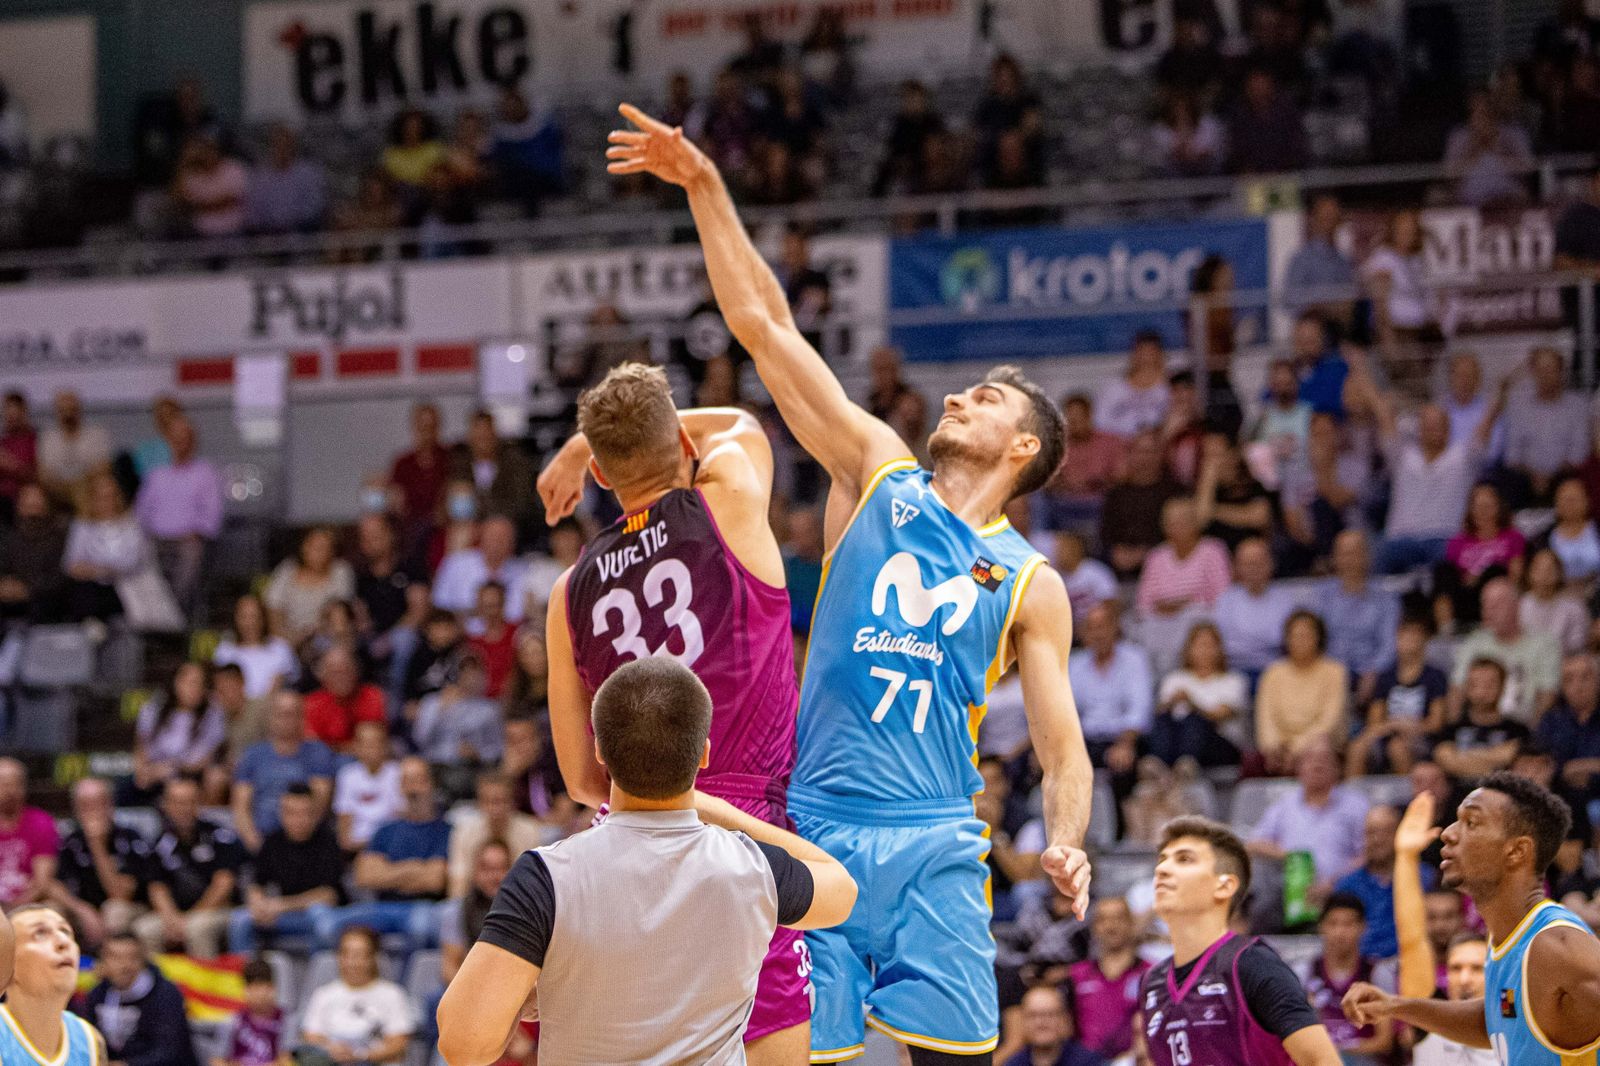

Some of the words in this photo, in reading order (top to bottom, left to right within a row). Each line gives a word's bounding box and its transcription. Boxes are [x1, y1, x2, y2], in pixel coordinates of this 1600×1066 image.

[295, 2, 529, 113] ekke
[248, 270, 409, 342] Pujol
[592, 558, 705, 669] 33
[853, 626, 943, 666] Estudiants
[869, 666, 933, 734] 71
[792, 940, 813, 977] 3
[1167, 1030, 1192, 1066] 13
